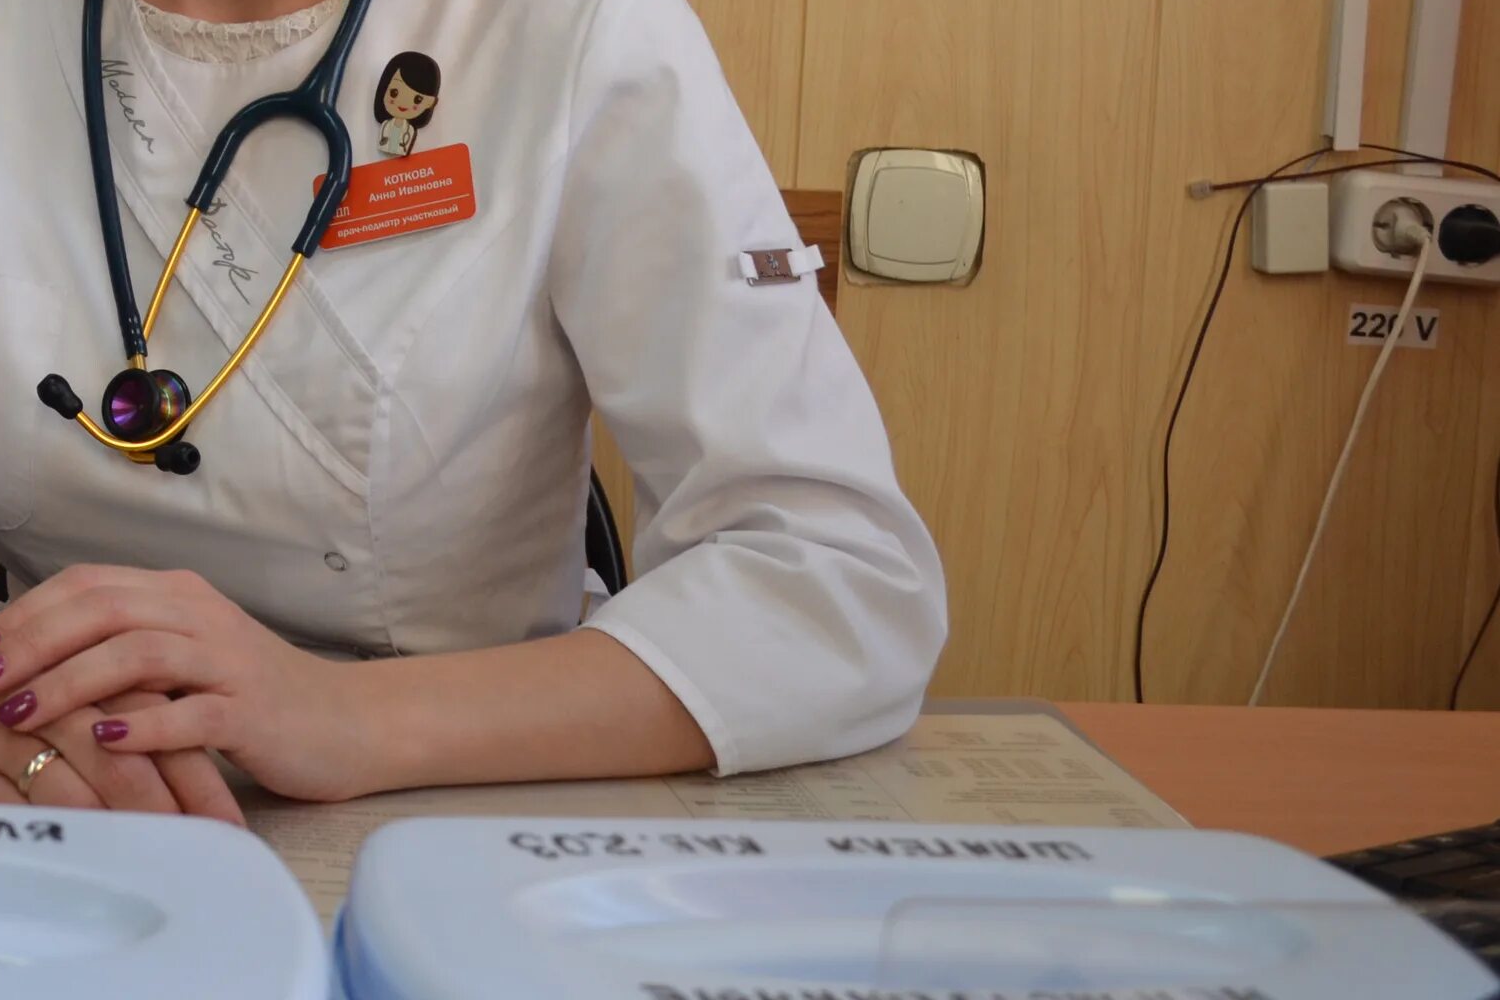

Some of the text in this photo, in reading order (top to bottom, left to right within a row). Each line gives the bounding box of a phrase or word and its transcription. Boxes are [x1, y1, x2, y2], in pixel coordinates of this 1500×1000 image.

[383, 166, 436, 187] КОТКОВА
[368, 177, 454, 204] Анна Ивановна
[337, 204, 459, 240] врач-педиатр участковый
[1416, 316, 1438, 341] V
